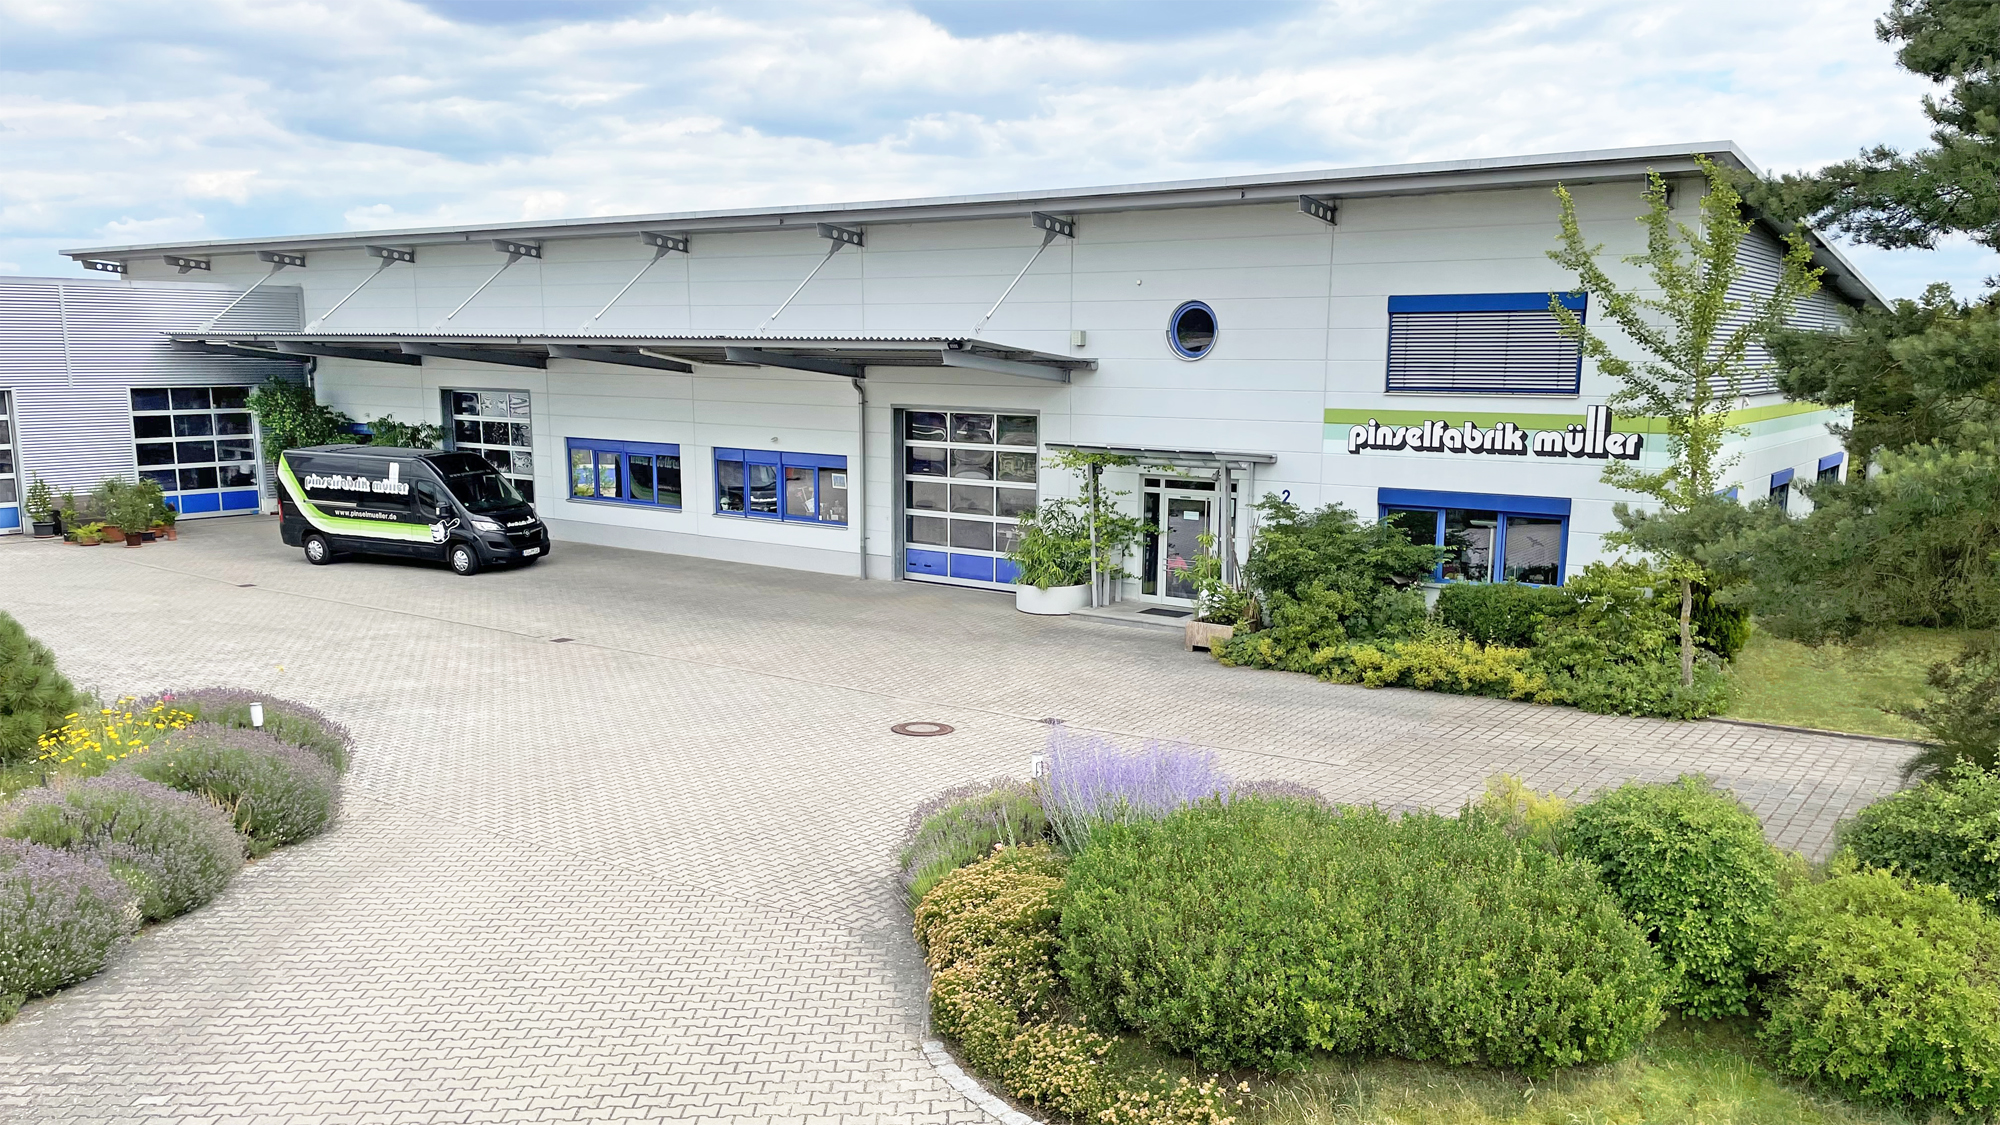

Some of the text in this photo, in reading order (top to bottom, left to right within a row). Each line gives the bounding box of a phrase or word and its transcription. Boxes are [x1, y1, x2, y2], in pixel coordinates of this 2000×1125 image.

[1348, 405, 1644, 460] pinselfabrik müller
[304, 462, 409, 495] pinselfabrik müller
[1282, 489, 1291, 505] 2
[335, 509, 397, 520] www.pinselmueller.de
